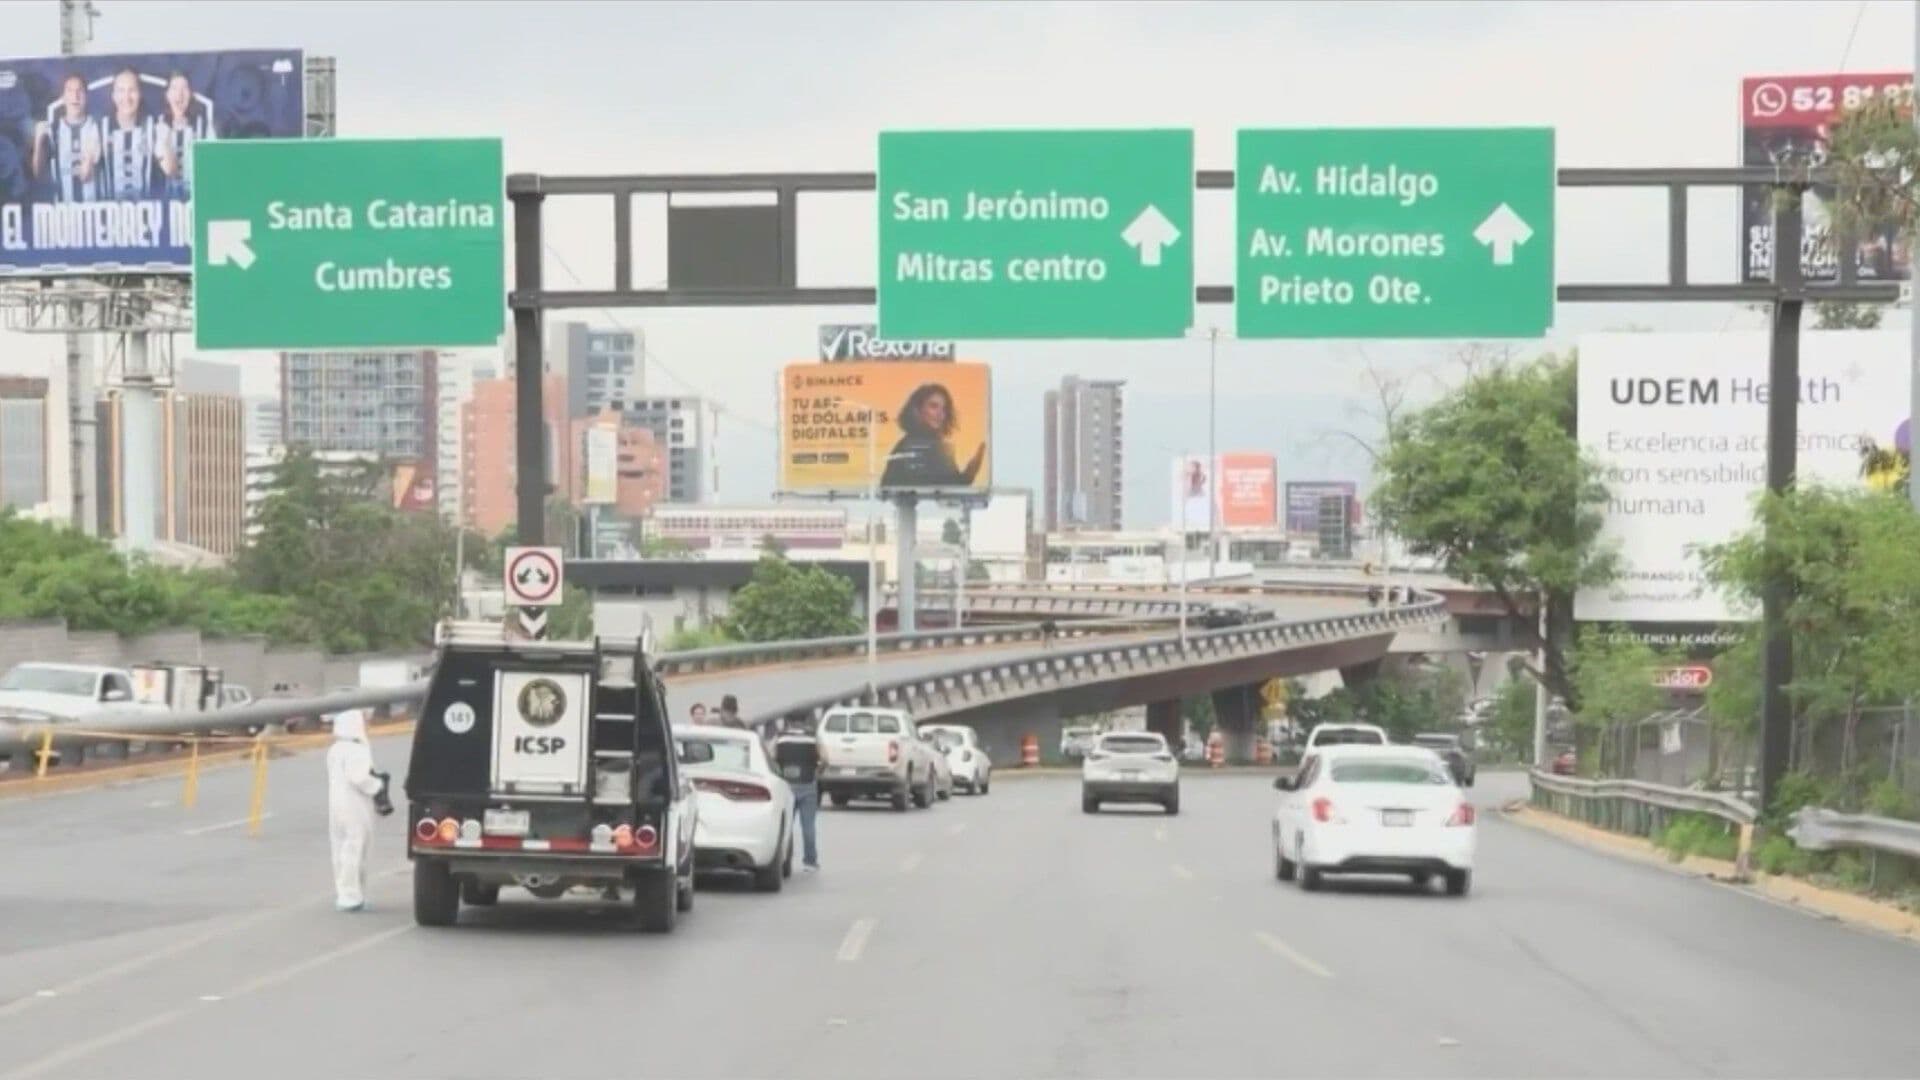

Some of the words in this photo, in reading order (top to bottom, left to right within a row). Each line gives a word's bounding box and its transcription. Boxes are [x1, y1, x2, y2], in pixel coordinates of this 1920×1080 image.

[1791, 87, 1835, 111] 52
[1258, 164, 1302, 194] Av.
[1316, 164, 1439, 206] Hidalgo
[267, 201, 353, 230] Santa
[366, 198, 495, 229] Catarina
[893, 190, 950, 221] San
[963, 189, 1110, 221] Jerónimo
[3, 203, 28, 249] EL
[32, 201, 164, 248] MONTERREY
[1250, 227, 1293, 257] Av.
[1306, 227, 1445, 257] Morones
[315, 258, 453, 291] Cumbres
[896, 252, 994, 282] Mitras
[1007, 254, 1107, 282] centro
[1260, 275, 1355, 305] Prieto
[1368, 275, 1432, 305] Ote.
[805, 375, 864, 386] BINANCE
[1610, 378, 1719, 406] UDEM
[1730, 376, 1841, 404] Helth
[792, 398, 810, 410] TU
[792, 413, 809, 425] DE
[792, 427, 869, 440] DIGITALES
[1606, 431, 1729, 453] Excelencia
[1735, 430, 1864, 452] acémica
[1607, 496, 1706, 516] humana
[514, 736, 566, 755] ICSP
